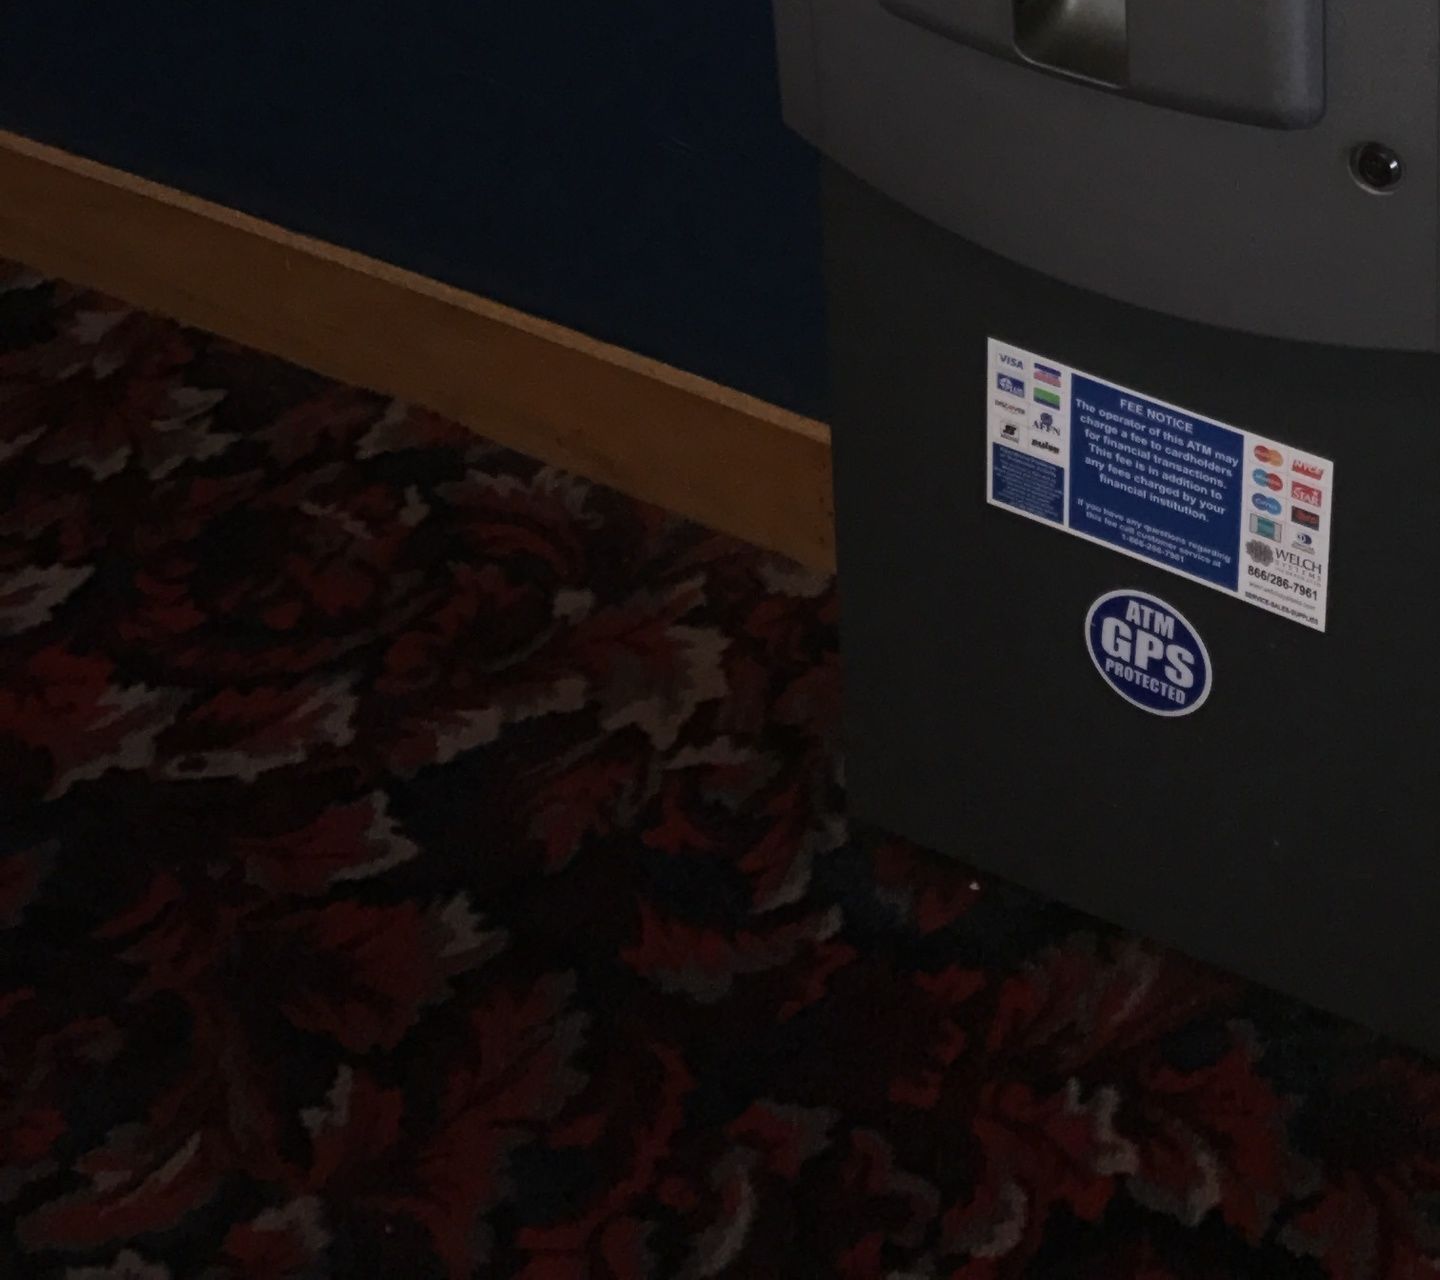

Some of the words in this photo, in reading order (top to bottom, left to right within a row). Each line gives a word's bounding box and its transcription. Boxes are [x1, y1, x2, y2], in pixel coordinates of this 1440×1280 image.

[999, 353, 1024, 370] VISA
[1076, 399, 1096, 413] The
[1099, 409, 1146, 432] operator
[1149, 427, 1161, 437] of
[1162, 431, 1184, 446] this
[1187, 440, 1211, 456] ATM
[1215, 452, 1238, 468] may
[1120, 398, 1143, 416] FEE
[1147, 409, 1193, 434] NOTICE
[1080, 416, 1118, 436] charge
[1120, 430, 1128, 439] a
[1131, 432, 1148, 446] fee
[1151, 440, 1161, 451] to
[1165, 447, 1232, 477] cardholders
[1085, 428, 1100, 442] for
[1103, 435, 1150, 460] financial
[1153, 455, 1227, 489] transactions.
[1088, 442, 1112, 460] This
[1115, 453, 1133, 467] fee
[1135, 459, 1146, 471] is
[1149, 465, 1159, 477] in
[1162, 471, 1208, 495] addition
[1210, 489, 1223, 500] to
[1085, 456, 1104, 471] any
[1107, 463, 1131, 480] fees
[1134, 475, 1180, 498] charged
[1182, 491, 1197, 505] by
[1199, 499, 1227, 516] your
[1099, 472, 1147, 499] financial
[1150, 493, 1209, 522] institution.
[1292, 487, 1319, 506] STAR
[1247, 565, 1317, 601] 866/286-7961
[1275, 547, 1322, 575] WELCH
[1125, 599, 1175, 640] ATM
[1101, 616, 1195, 688] GPS
[1105, 657, 1187, 705] PROTECTED
